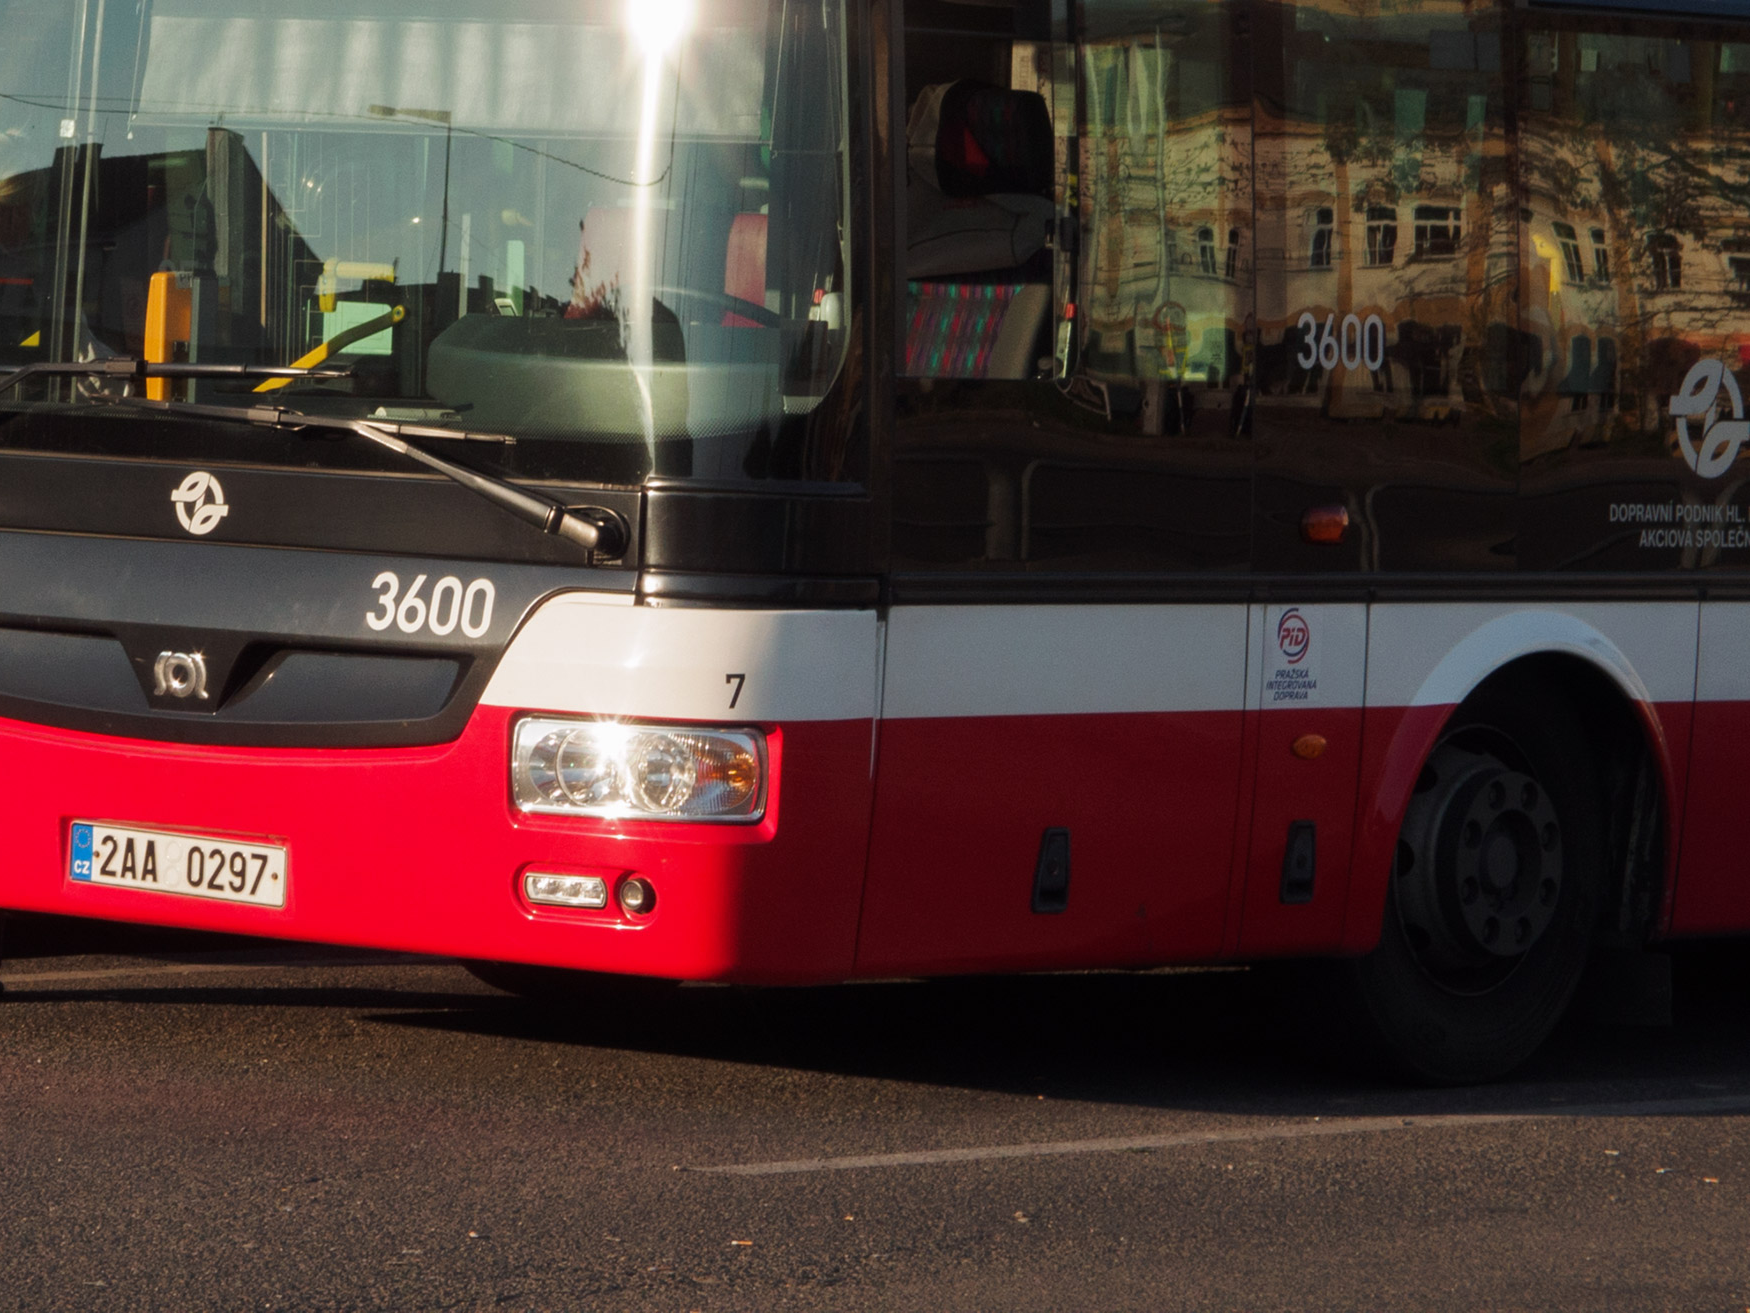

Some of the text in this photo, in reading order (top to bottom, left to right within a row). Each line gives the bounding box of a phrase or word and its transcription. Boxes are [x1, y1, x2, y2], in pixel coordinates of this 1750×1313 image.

[1296, 311, 1384, 371] 3600
[1609, 499, 1746, 524] DOPRAVNÍ PODNIK HL.
[1638, 526, 1693, 548] AKCIOVÁ
[366, 571, 496, 639] 3600
[725, 673, 746, 709] 7
[74, 835, 268, 895] CZ 2AA 0297
